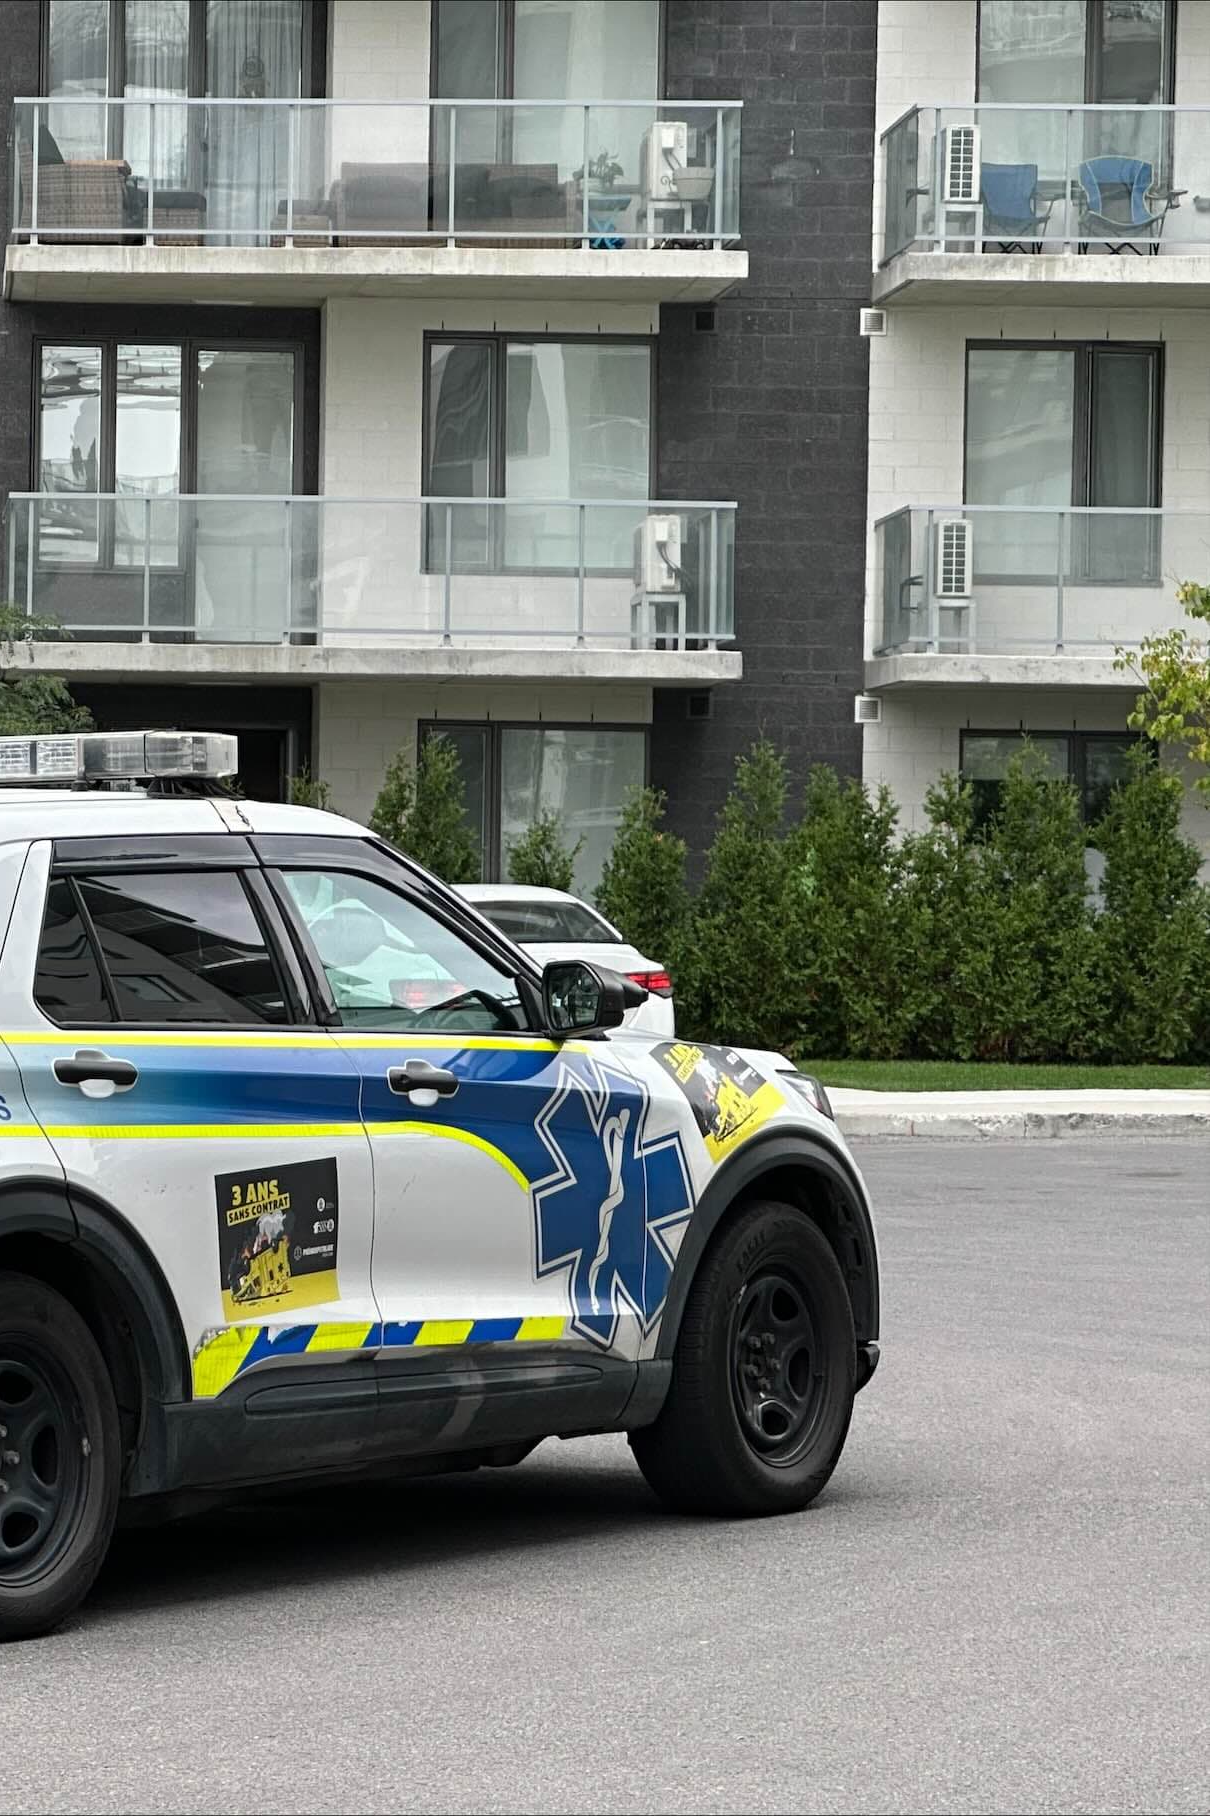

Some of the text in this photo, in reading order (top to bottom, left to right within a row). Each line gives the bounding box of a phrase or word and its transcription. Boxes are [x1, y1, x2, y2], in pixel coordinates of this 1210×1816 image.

[231, 1179, 279, 1206] 3 ANS
[228, 1195, 289, 1223] SANS CONTRAT
